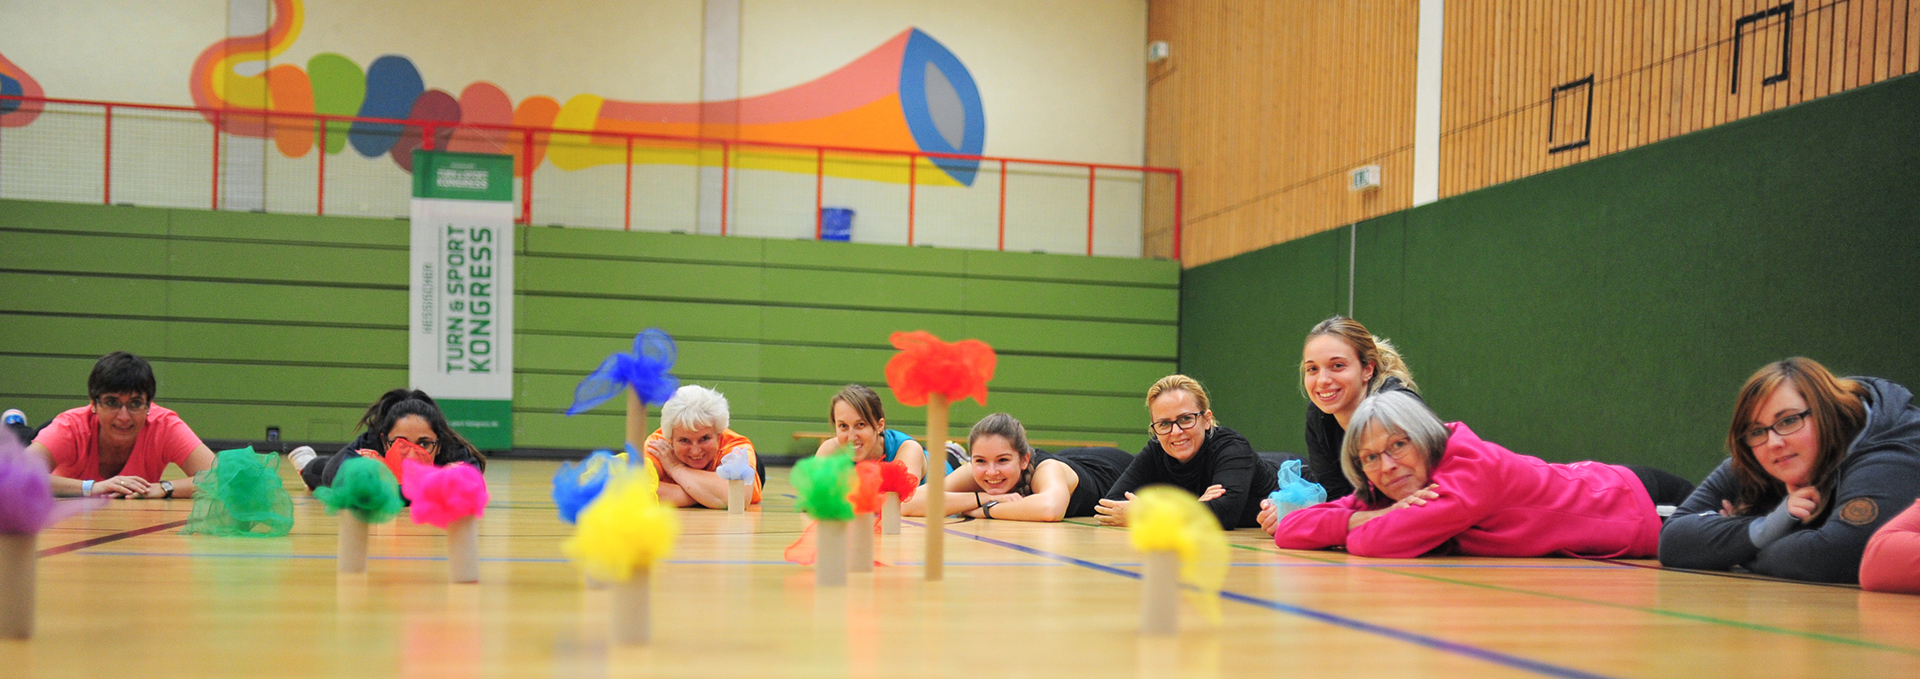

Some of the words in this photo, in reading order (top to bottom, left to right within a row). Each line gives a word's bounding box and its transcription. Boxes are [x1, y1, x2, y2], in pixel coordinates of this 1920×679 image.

[447, 225, 464, 294] SPORT
[450, 300, 464, 312] &
[469, 227, 492, 373] KONGRESS
[447, 317, 464, 374] TURN
